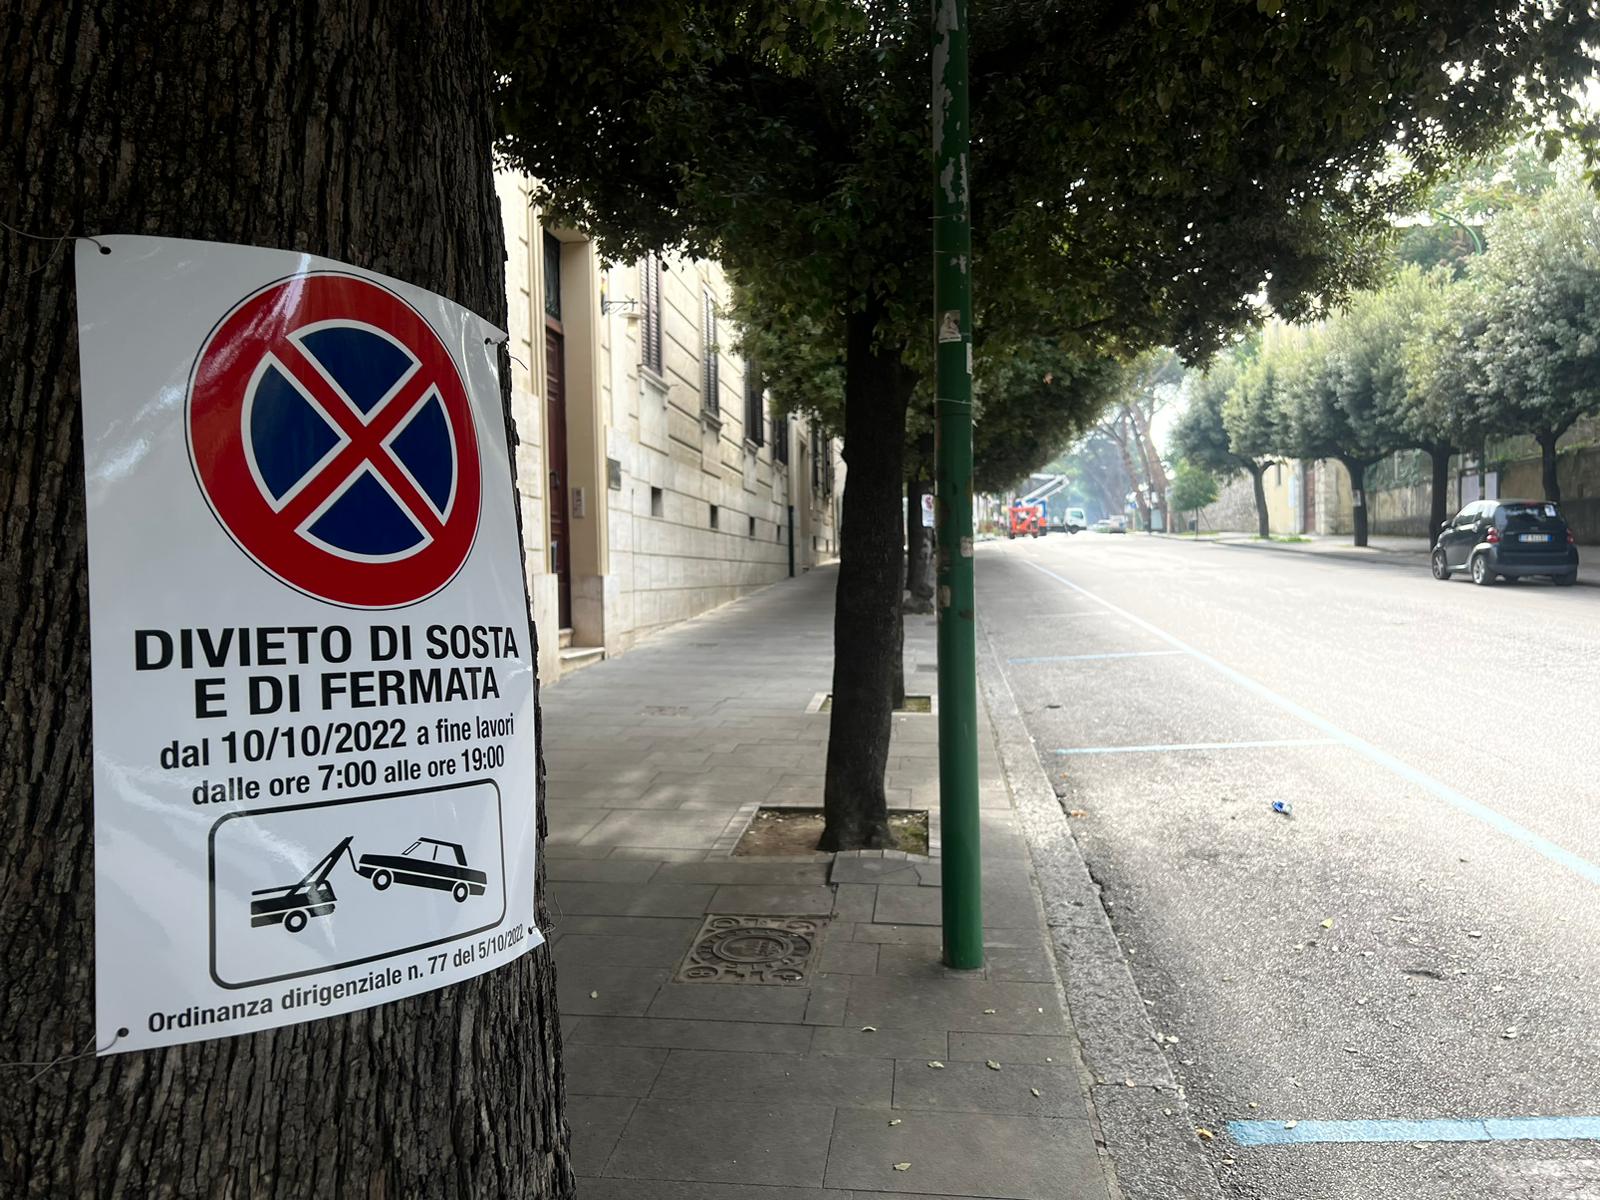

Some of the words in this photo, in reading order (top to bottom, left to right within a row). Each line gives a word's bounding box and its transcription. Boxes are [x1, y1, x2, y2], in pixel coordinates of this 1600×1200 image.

[135, 626, 352, 671] DIVIETO
[370, 625, 412, 661] DI
[426, 625, 519, 659] SOSTA
[194, 678, 227, 718] E
[248, 673, 299, 715] DI
[321, 667, 500, 710] FERMATA
[160, 741, 209, 769] dal
[222, 719, 407, 763] 10/10/2022
[417, 727, 429, 745] a
[435, 717, 471, 744] fine
[476, 713, 514, 740] lavori
[192, 777, 260, 805] dalle
[269, 773, 310, 796] ore
[318, 760, 377, 791] 7:00
[384, 759, 421, 783] alle
[428, 758, 456, 778] ore
[461, 745, 504, 773] 19:00
[148, 996, 273, 1032] Ordinanza
[281, 968, 402, 1007] dirigenziale
[408, 963, 423, 982] n.
[428, 954, 448, 975] 77
[453, 944, 475, 967] del
[478, 923, 524, 960] 5/10/2022
